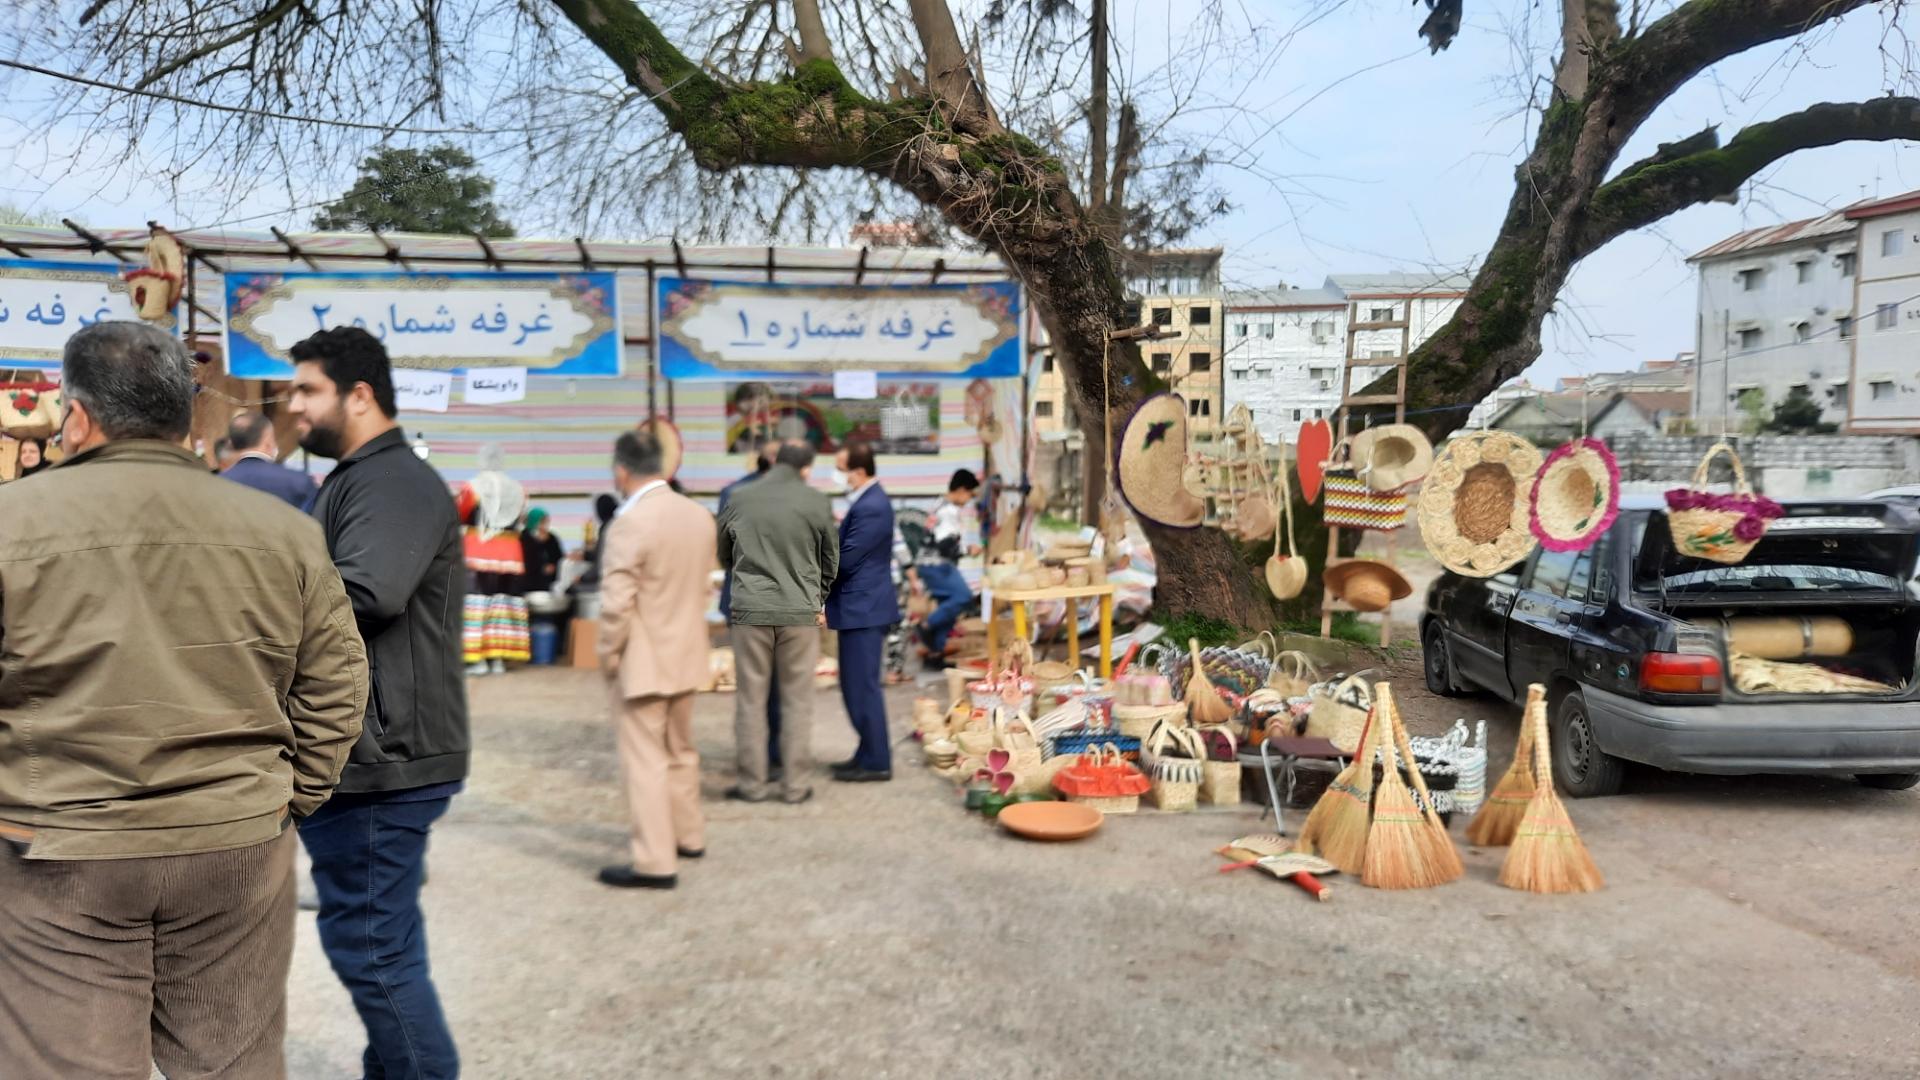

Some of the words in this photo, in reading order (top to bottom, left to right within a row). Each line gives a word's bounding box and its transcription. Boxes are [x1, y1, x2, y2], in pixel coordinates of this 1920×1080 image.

[311, 304, 332, 330] ۲
[469, 302, 553, 346] غرفه
[766, 310, 865, 348] شماره
[878, 310, 956, 350] غرفه
